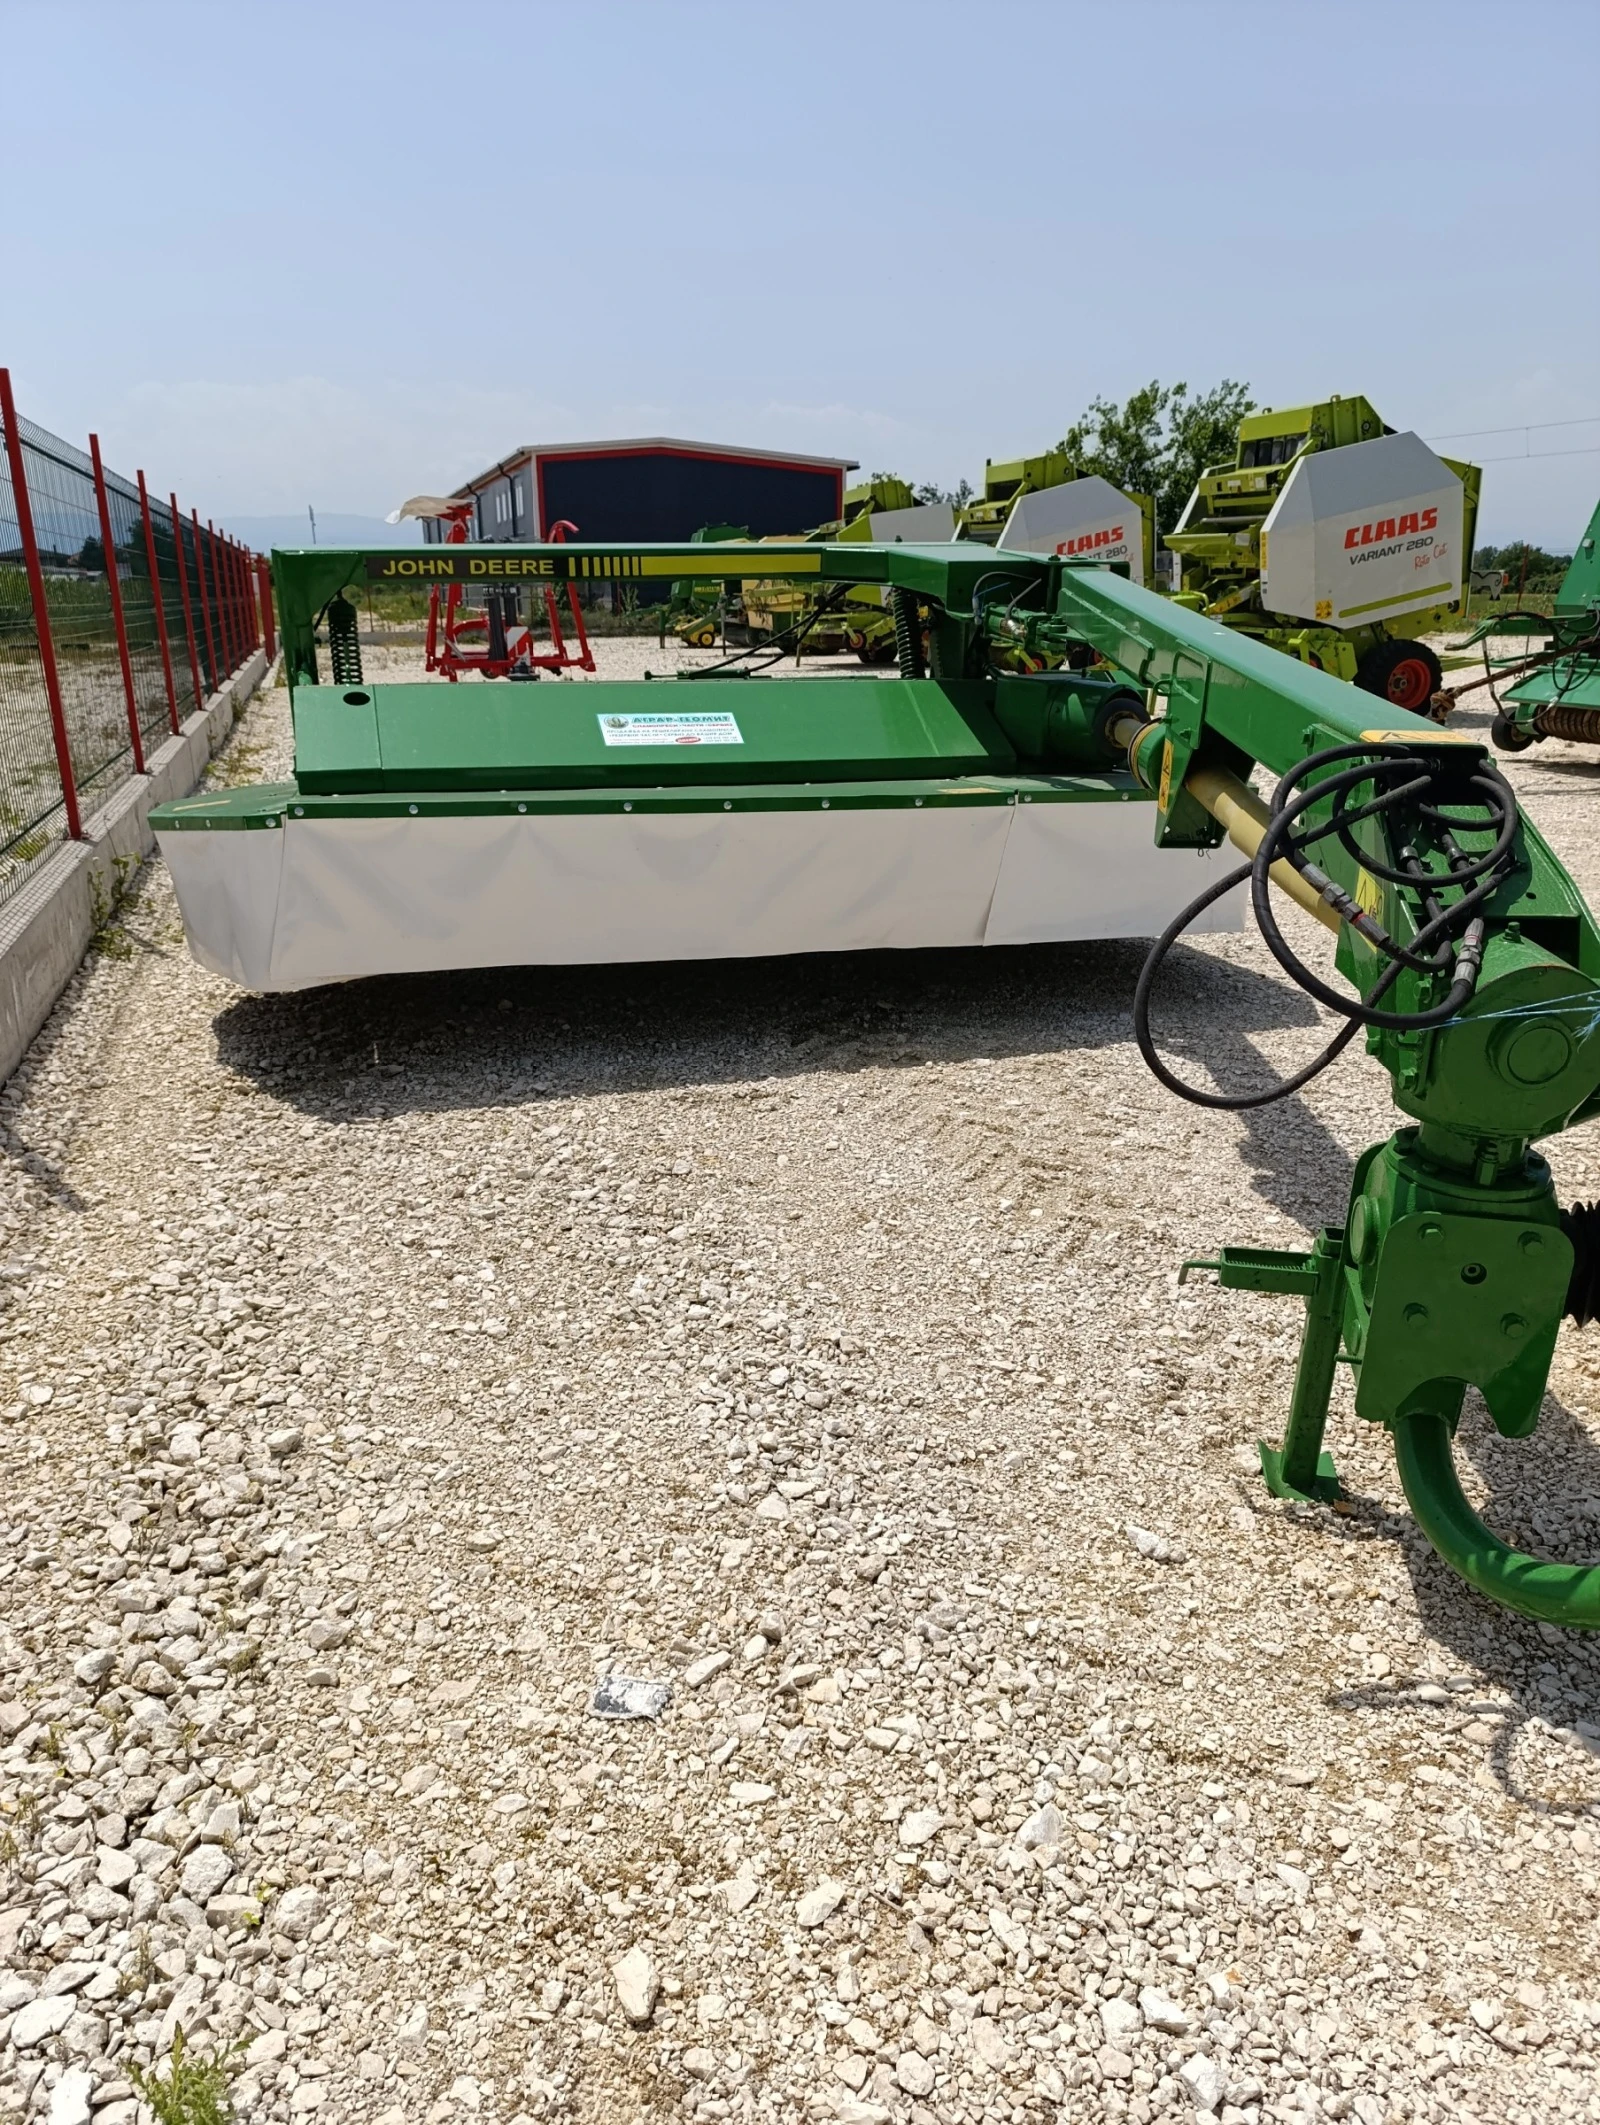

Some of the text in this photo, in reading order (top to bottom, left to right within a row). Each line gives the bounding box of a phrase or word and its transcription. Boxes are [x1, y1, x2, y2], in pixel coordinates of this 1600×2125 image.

[1056, 526, 1124, 555] CLAAS
[1344, 507, 1438, 549] CLAAS
[1105, 544, 1128, 559] 280
[1349, 536, 1434, 566] VARIANT 280
[383, 560, 554, 575] JOHN DEERE
